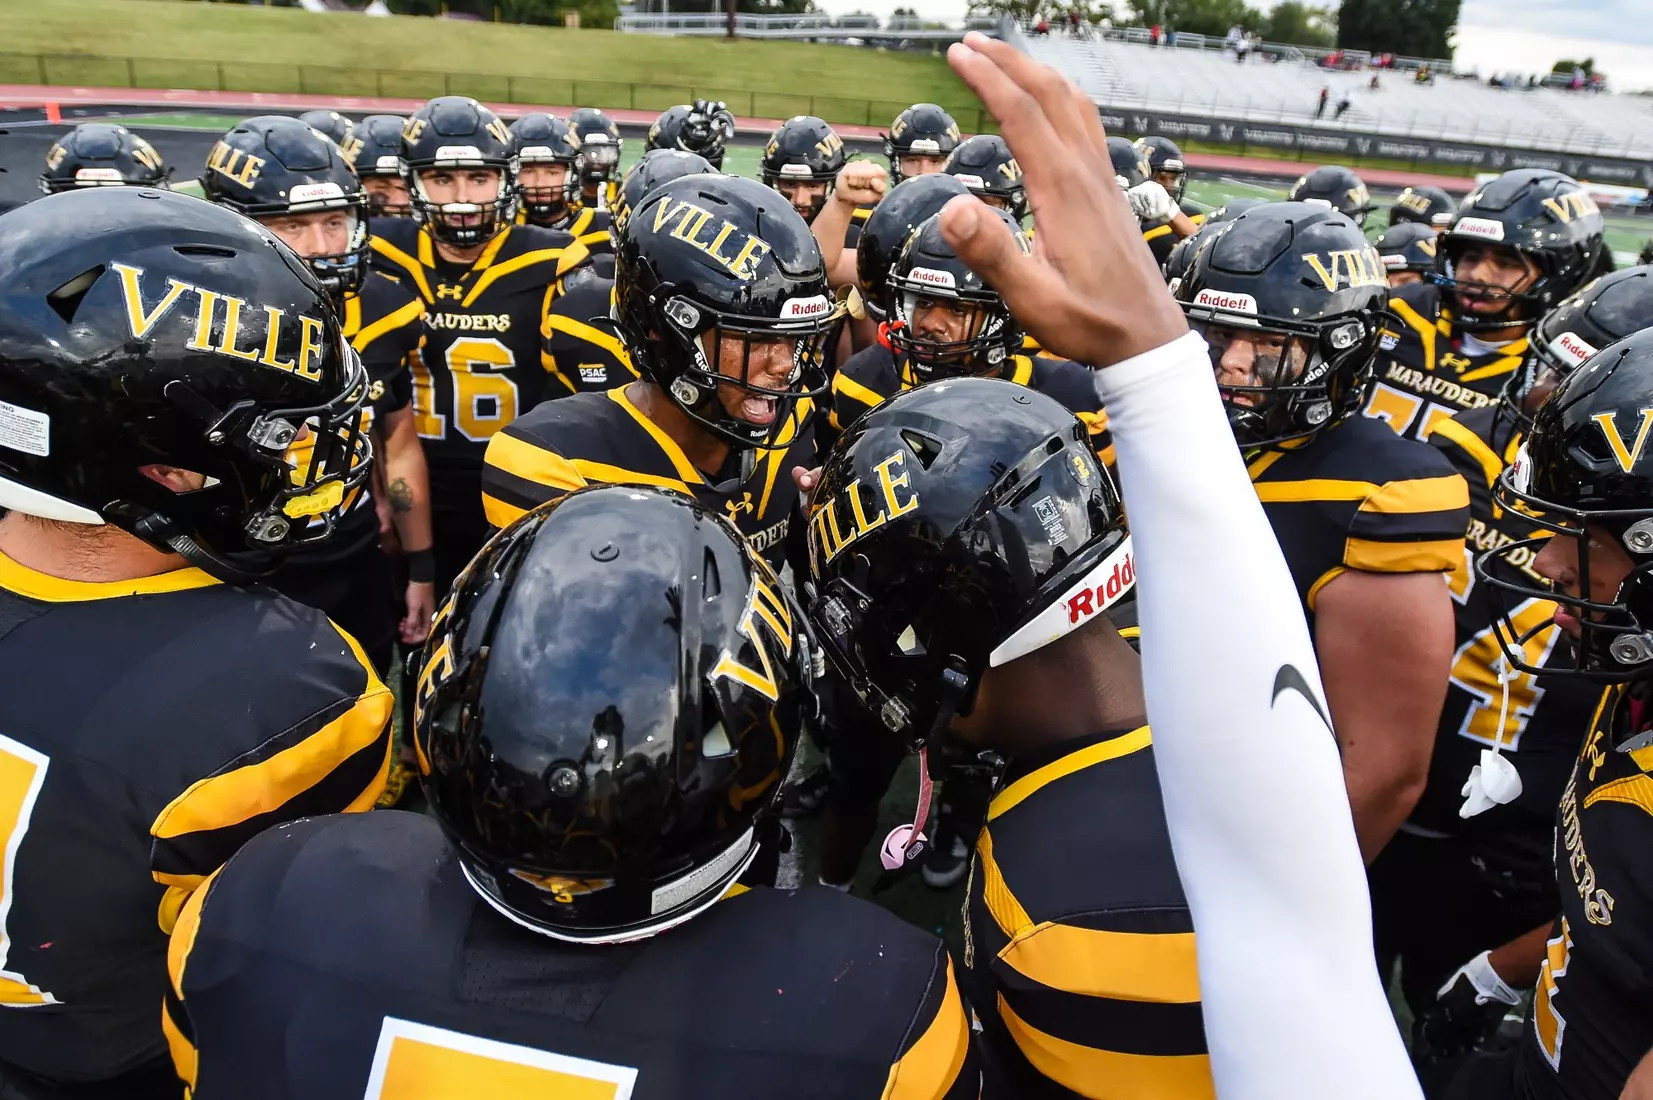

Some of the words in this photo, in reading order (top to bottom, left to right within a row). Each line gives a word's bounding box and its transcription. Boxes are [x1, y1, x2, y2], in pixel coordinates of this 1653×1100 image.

[653, 196, 772, 281] VILLE
[912, 270, 948, 284] Riddell
[791, 302, 826, 315] Riddell
[1199, 293, 1248, 310] Riddell
[110, 260, 324, 382] VILLE
[579, 368, 607, 377] PSAC
[408, 337, 519, 442] 16
